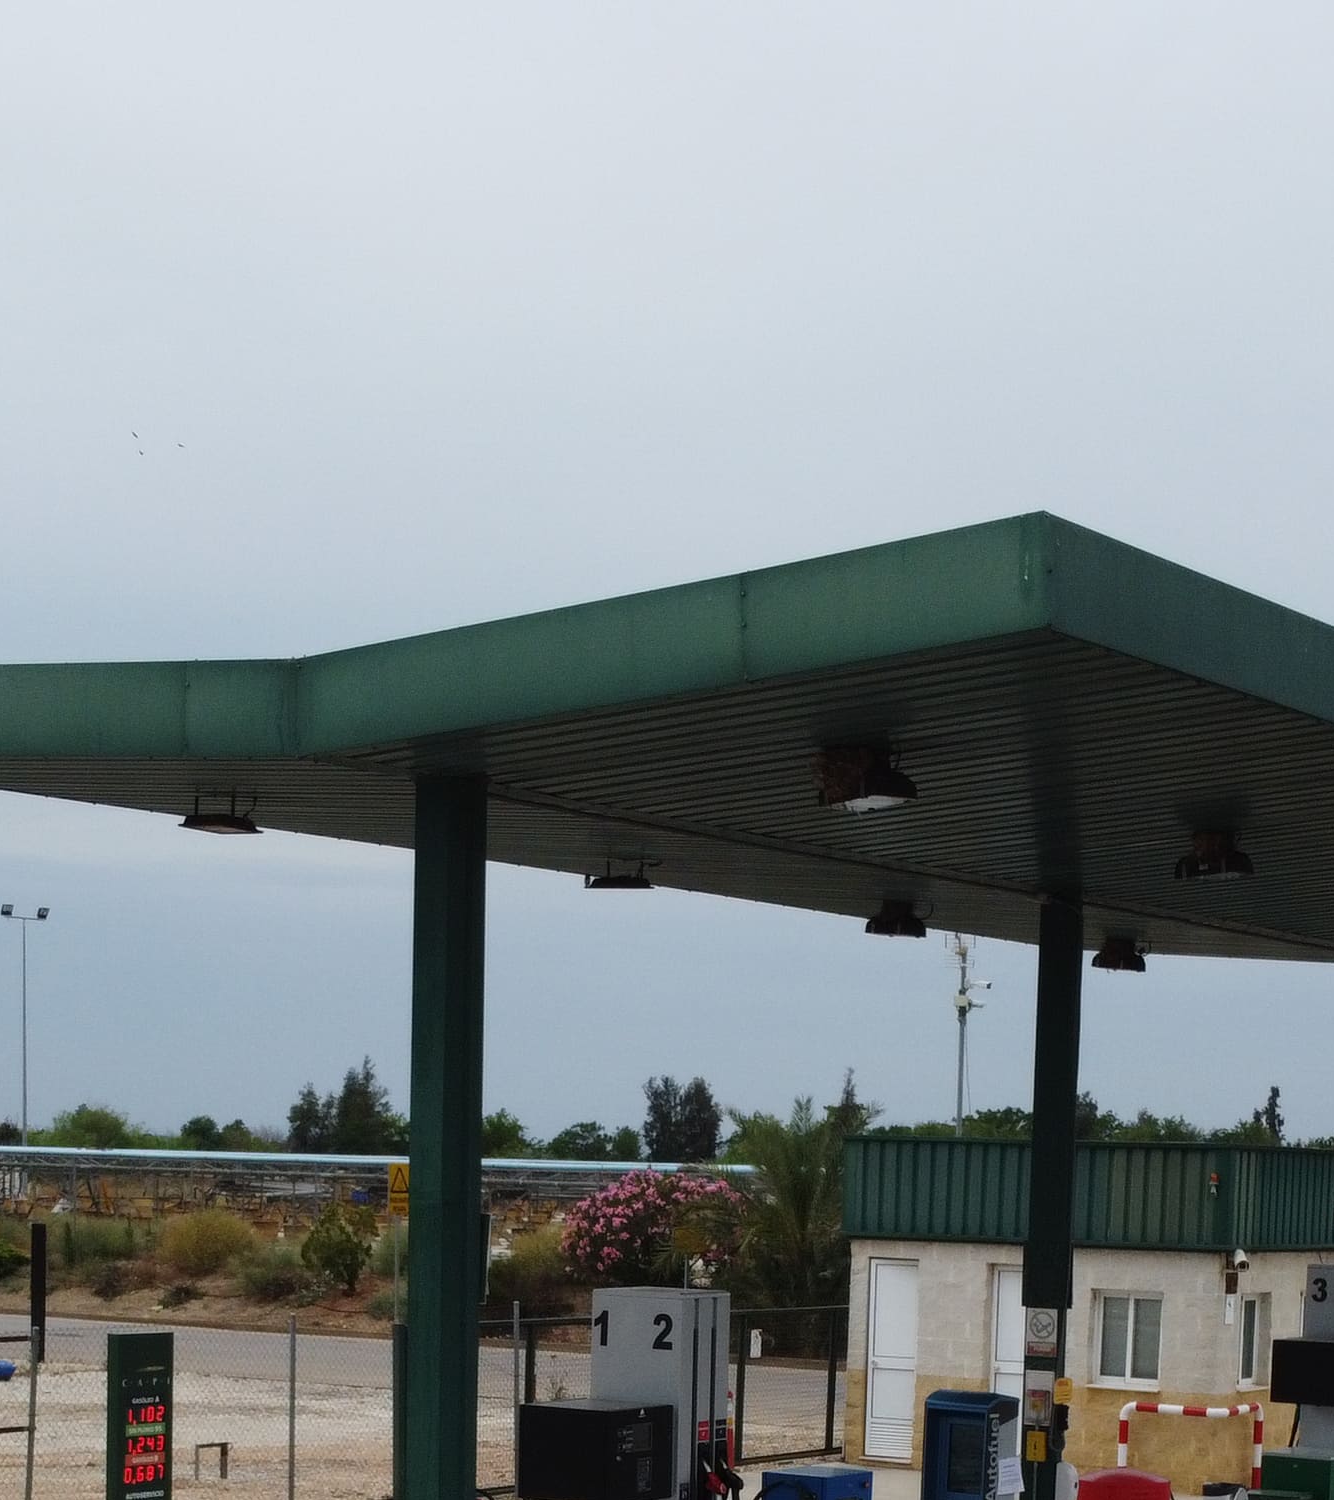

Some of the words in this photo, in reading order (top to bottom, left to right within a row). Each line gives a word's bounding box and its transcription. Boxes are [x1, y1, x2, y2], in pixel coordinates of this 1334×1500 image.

[1312, 1278, 1327, 1302] 3
[594, 1310, 609, 1346] 1
[652, 1313, 673, 1350] 2
